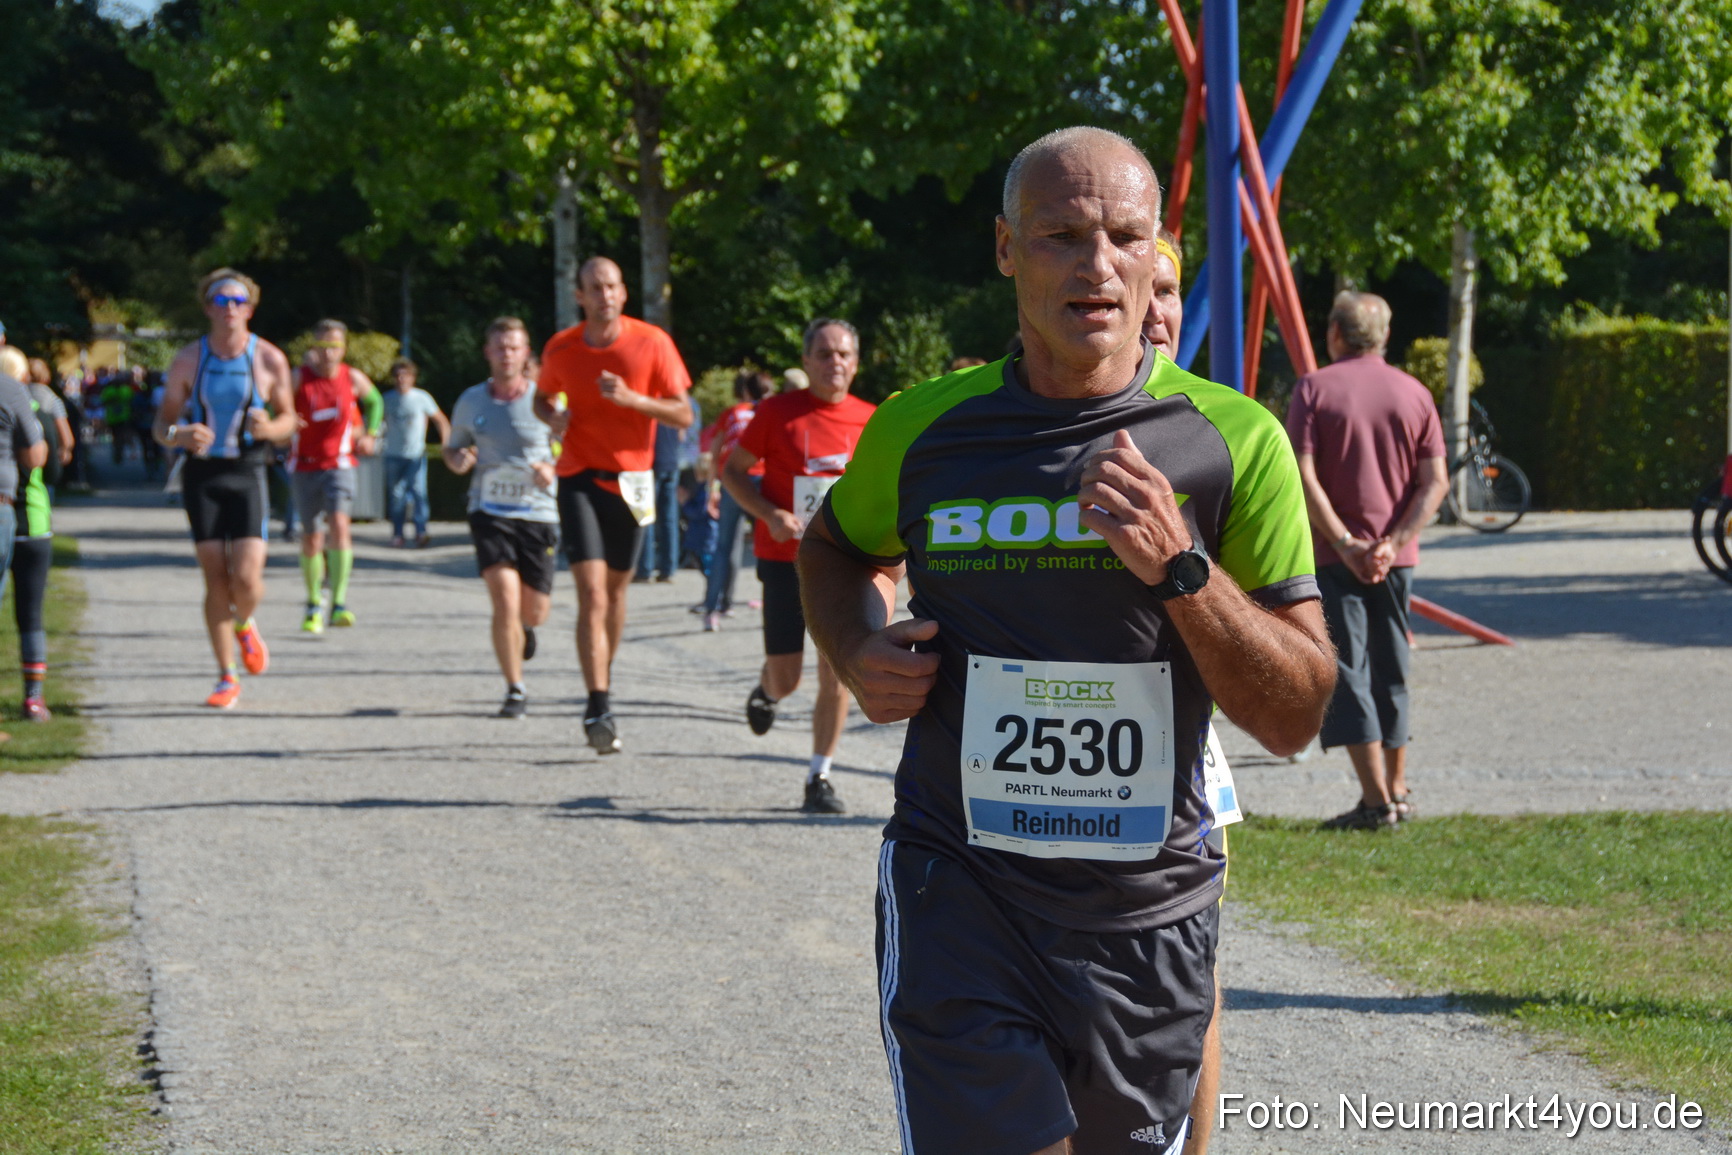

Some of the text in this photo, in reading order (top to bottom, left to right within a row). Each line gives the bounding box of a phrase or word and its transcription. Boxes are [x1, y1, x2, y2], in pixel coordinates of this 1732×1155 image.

[925, 495, 1191, 551] BOC
[926, 553, 996, 575] inspired
[1004, 553, 1029, 573] by
[1036, 554, 1097, 569] smart
[1025, 678, 1115, 702] BOCK
[1025, 698, 1051, 708] inspired
[1085, 702, 1117, 710] concepts
[992, 714, 1143, 777] 2530
[972, 757, 982, 770] A
[1005, 783, 1112, 798] PARTL Neumarkt
[1012, 808, 1121, 838] Reinhold
